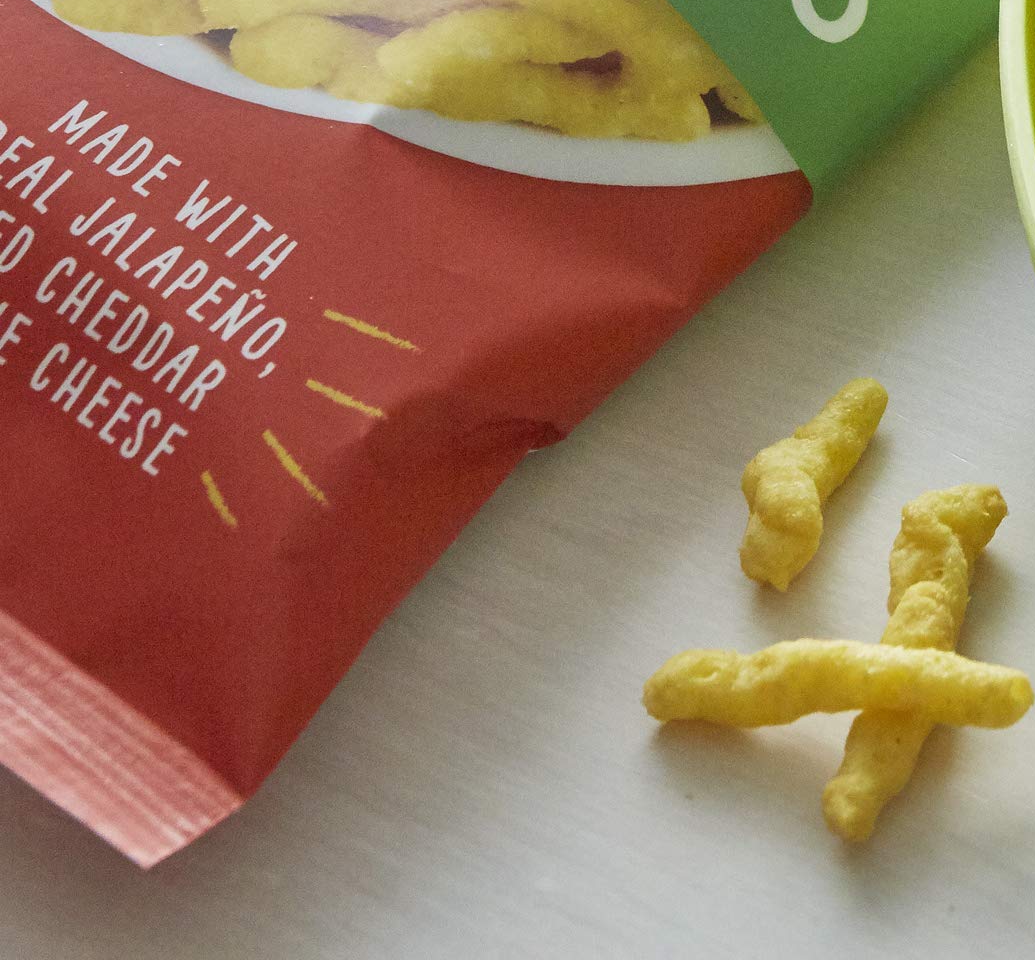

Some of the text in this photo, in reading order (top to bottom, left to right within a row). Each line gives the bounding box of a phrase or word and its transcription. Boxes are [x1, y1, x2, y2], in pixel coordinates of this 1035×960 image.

[48, 99, 298, 281] MADE WITH
[35, 256, 226, 412] CHEDDAR
[69, 197, 287, 379] JALAPEÑO,
[30, 343, 189, 476] CHEESE
